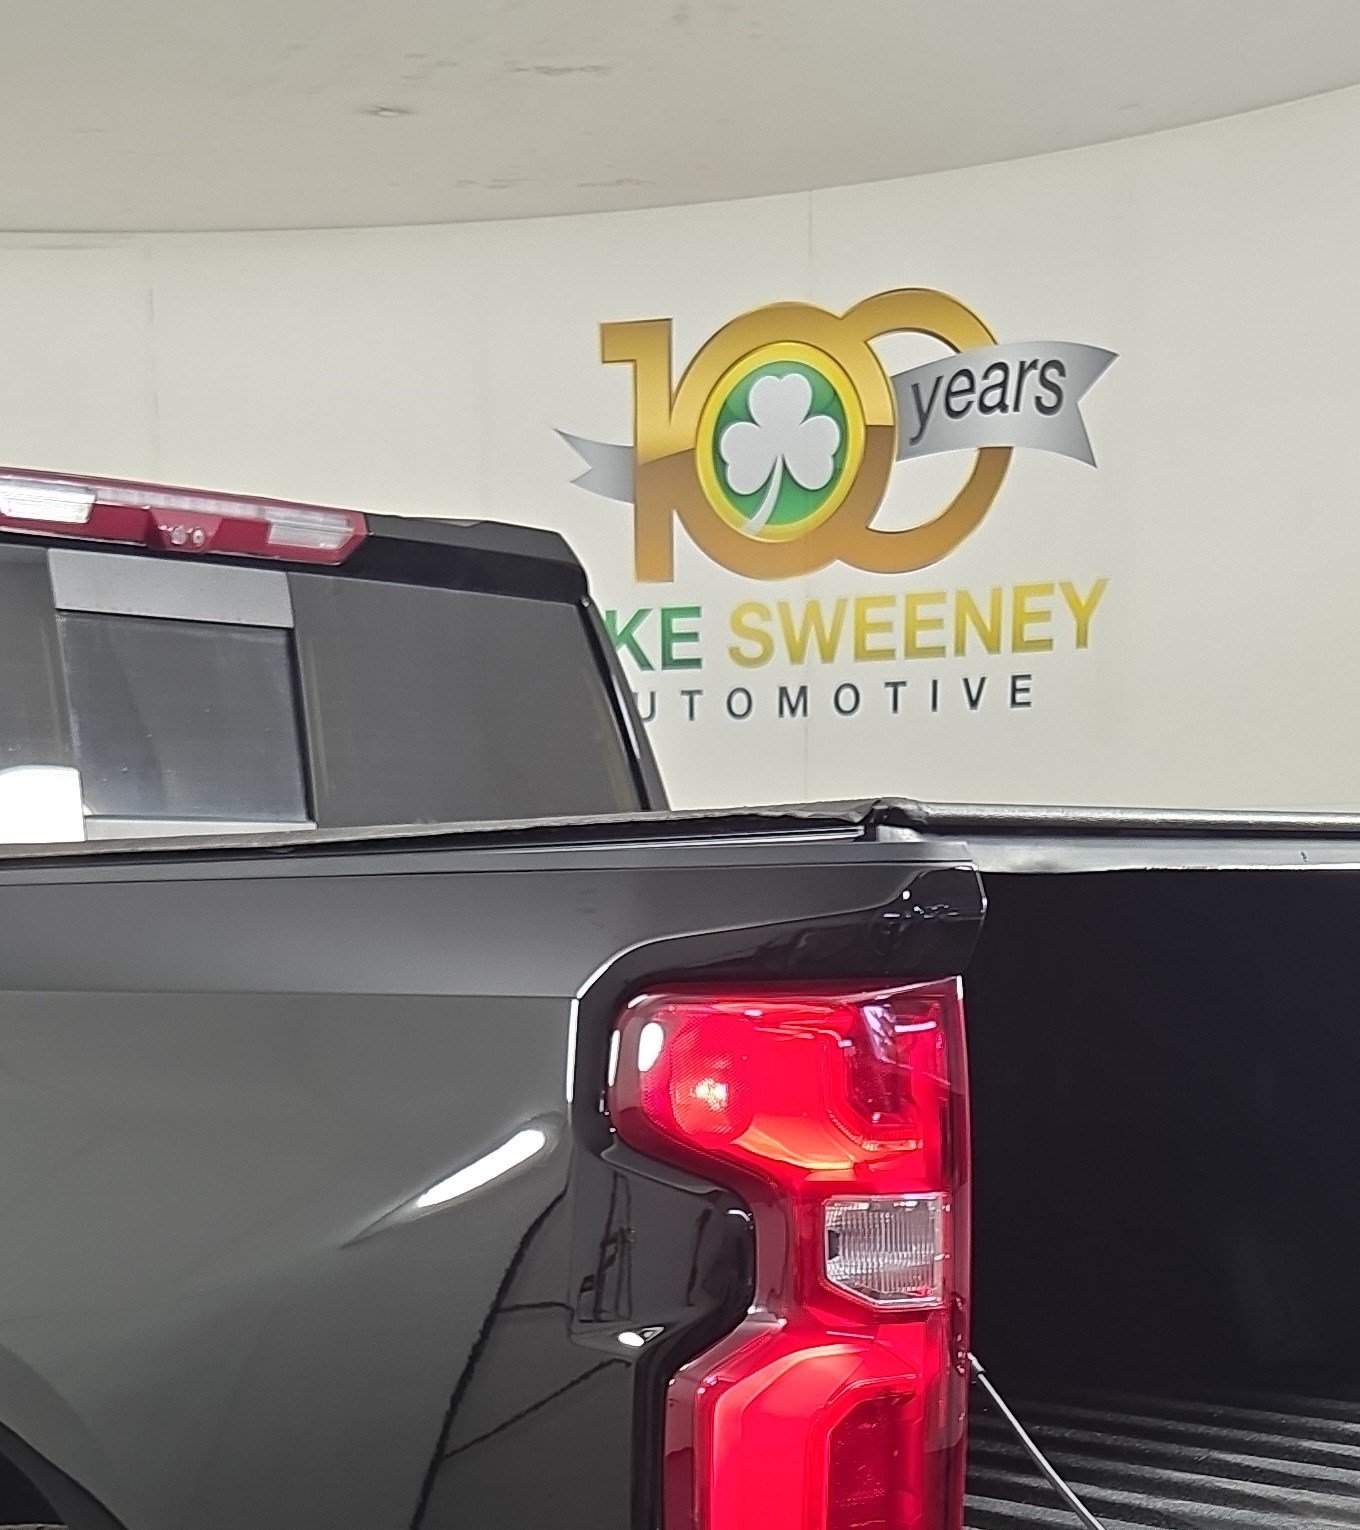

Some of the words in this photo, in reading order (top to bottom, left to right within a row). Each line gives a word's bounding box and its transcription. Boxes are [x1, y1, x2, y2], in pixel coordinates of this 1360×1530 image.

[599, 287, 1014, 582] 100
[909, 354, 1067, 447] years
[728, 577, 1110, 669] SWEENEY
